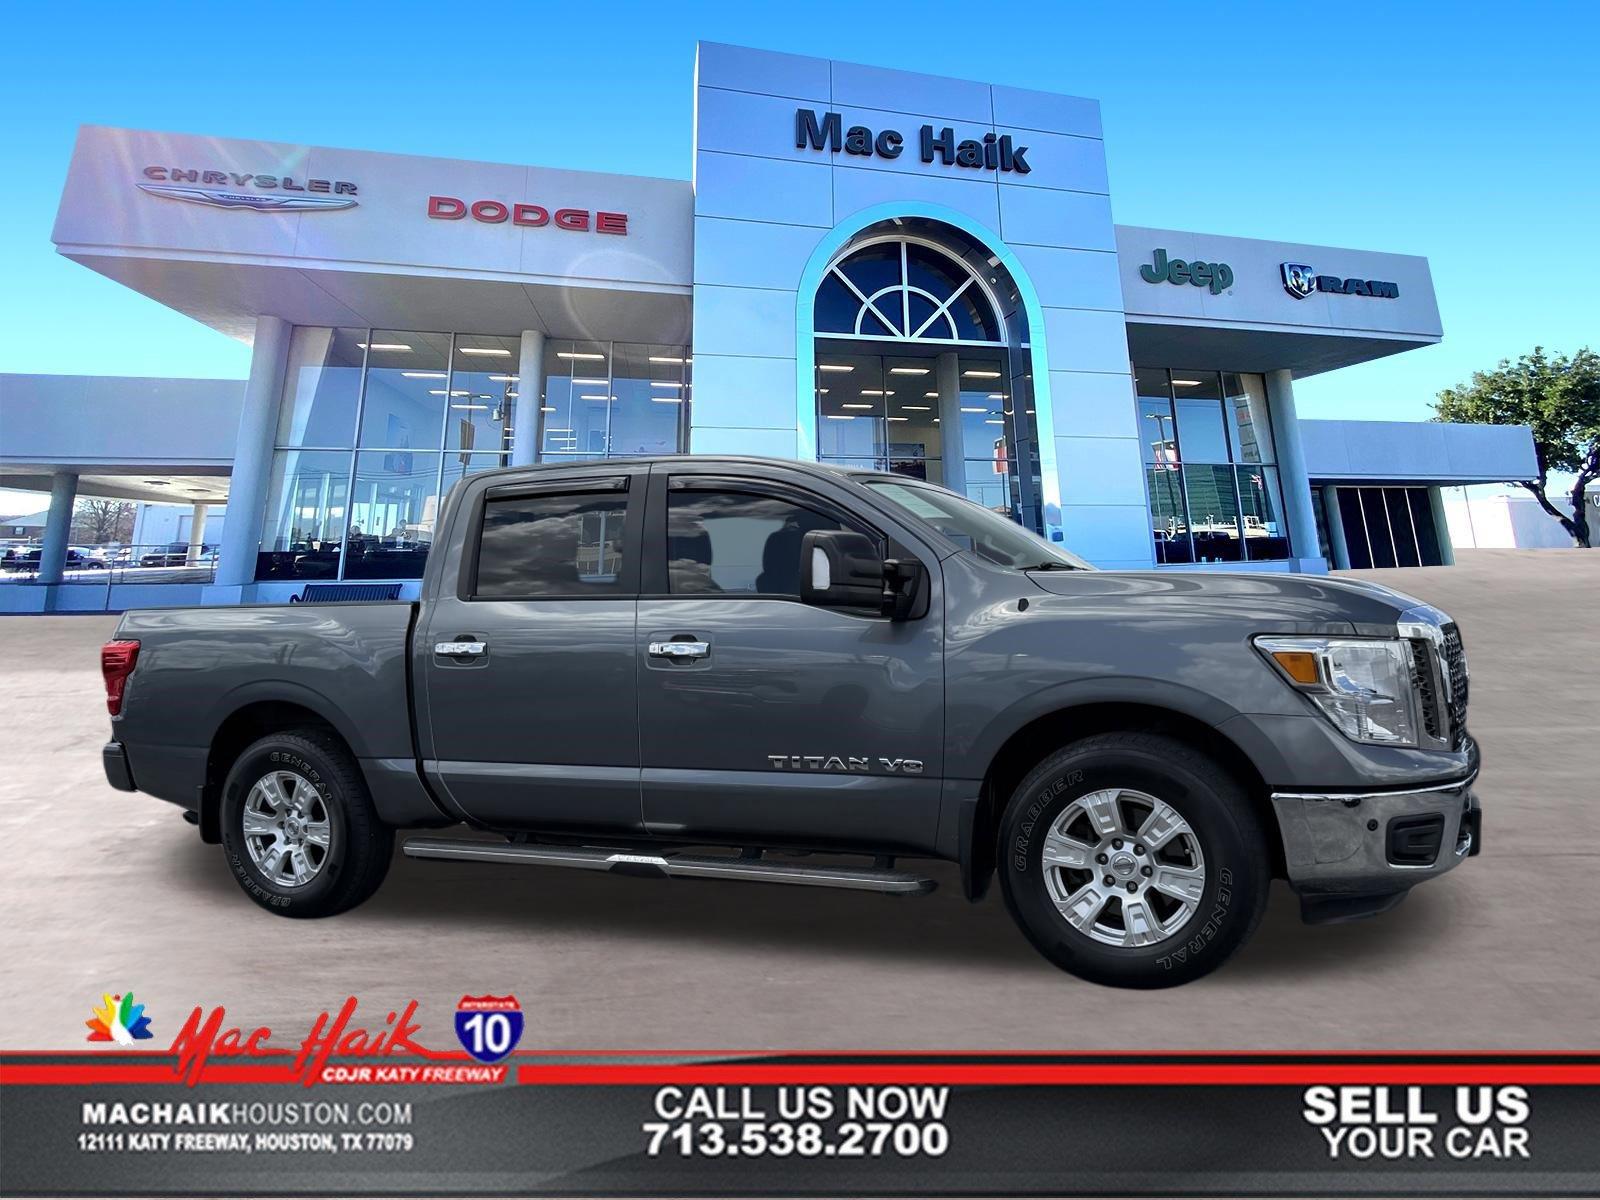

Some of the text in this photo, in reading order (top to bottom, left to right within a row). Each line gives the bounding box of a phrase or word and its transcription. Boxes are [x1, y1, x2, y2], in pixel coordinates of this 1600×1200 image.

[796, 108, 1032, 174] Mac Haik
[143, 166, 358, 196] CHRYSLER
[427, 196, 628, 236] DODGE
[1139, 248, 1234, 296] Jeep
[1316, 275, 1400, 299] RAM
[269, 751, 334, 802] GENERAL
[768, 755, 924, 773] TITAN V8
[1013, 768, 1084, 872] GRABBER
[1155, 867, 1233, 970] GENERAL
